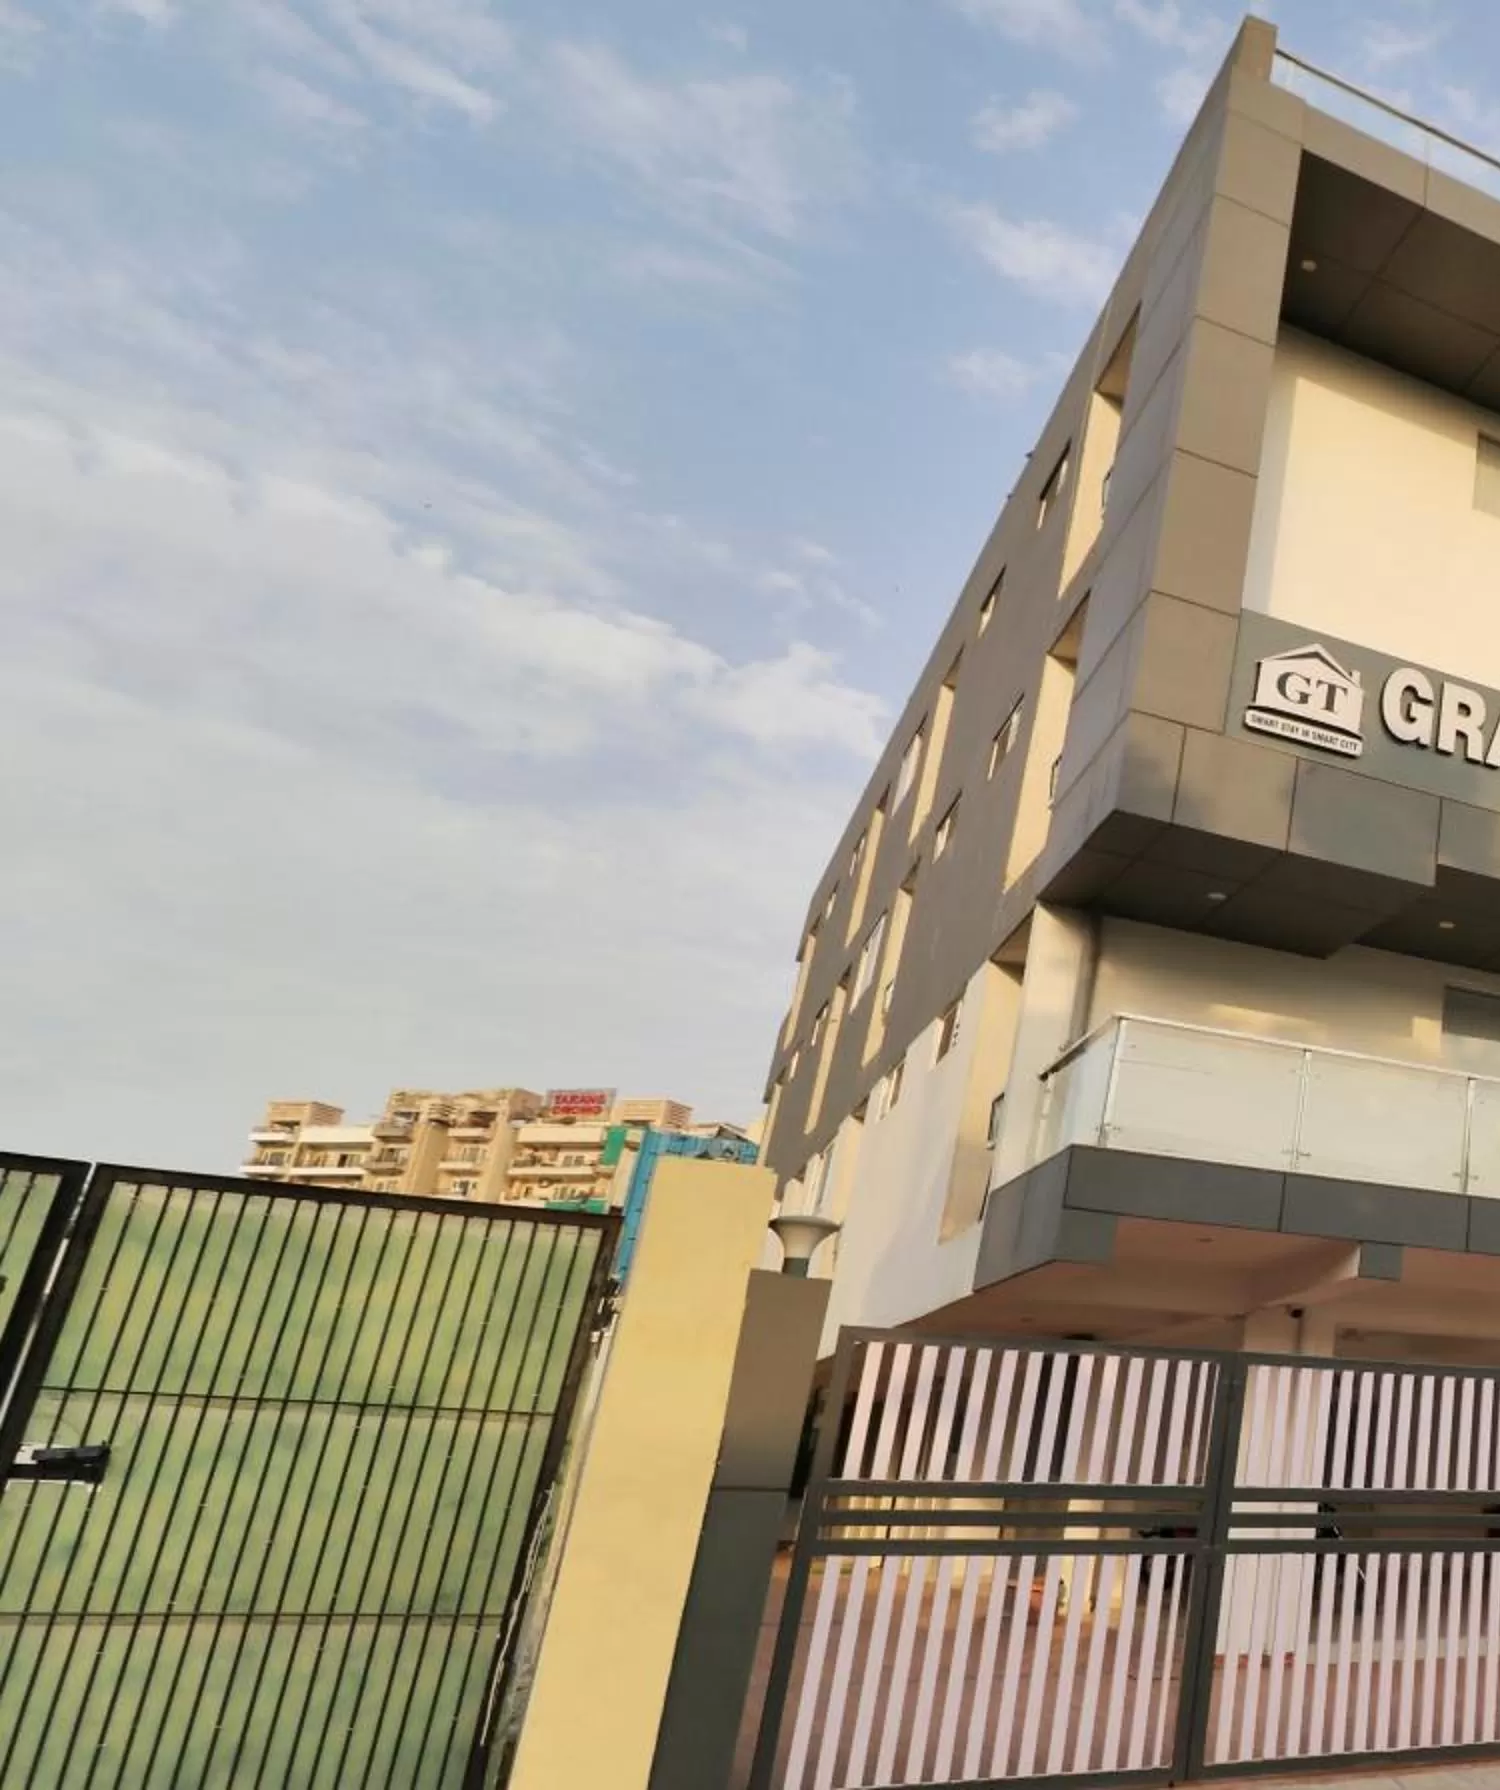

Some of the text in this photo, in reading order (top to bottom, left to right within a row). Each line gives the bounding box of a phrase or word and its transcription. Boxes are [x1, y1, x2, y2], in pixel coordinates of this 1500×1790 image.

[1277, 671, 1348, 714] GT
[1251, 713, 1279, 728] SMART
[1312, 731, 1339, 746] SMART
[1340, 740, 1359, 752] CITY
